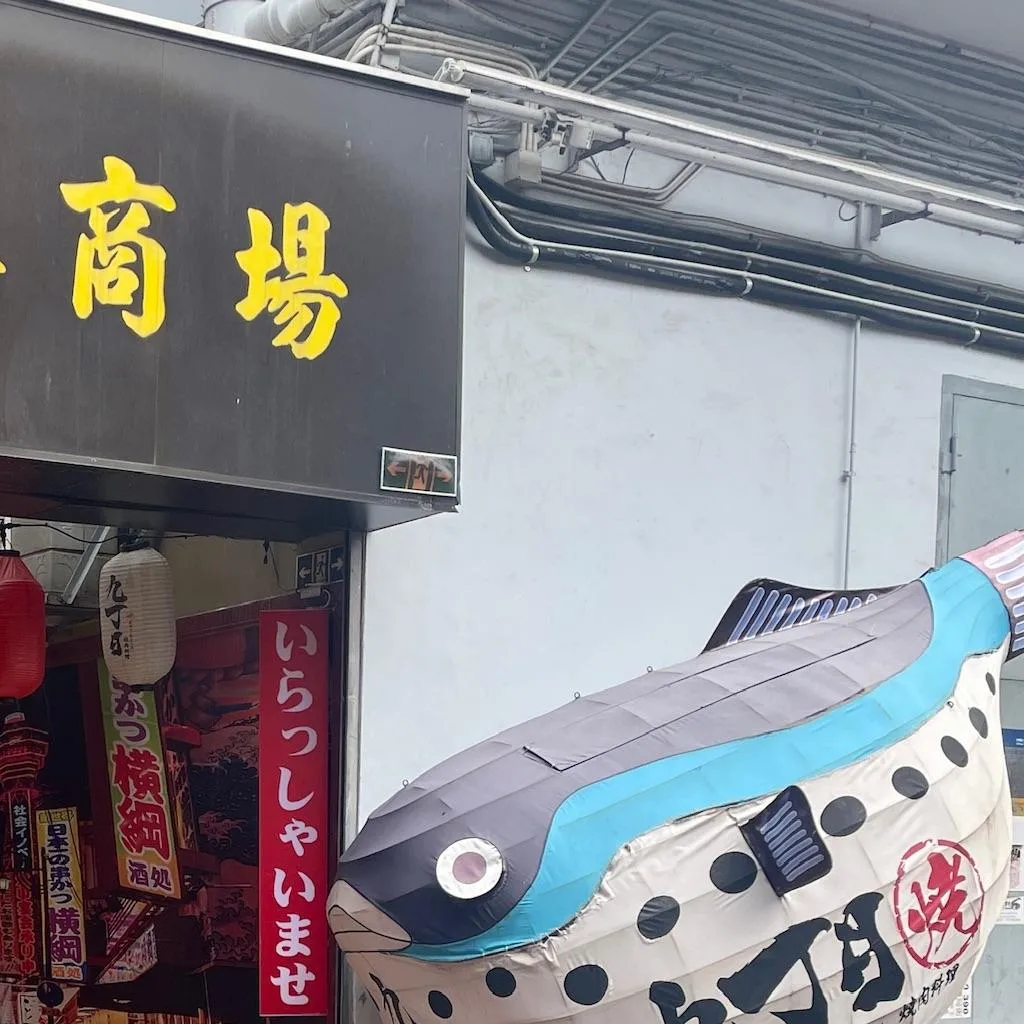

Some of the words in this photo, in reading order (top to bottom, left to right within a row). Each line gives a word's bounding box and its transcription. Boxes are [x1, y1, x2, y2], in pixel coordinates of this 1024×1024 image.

[105, 575, 128, 656] 九丁目
[112, 744, 172, 861] 横綱
[271, 620, 319, 1006] いらっしゃいませ
[129, 859, 172, 892] 酒処
[899, 963, 961, 1024] 焼肉料理
